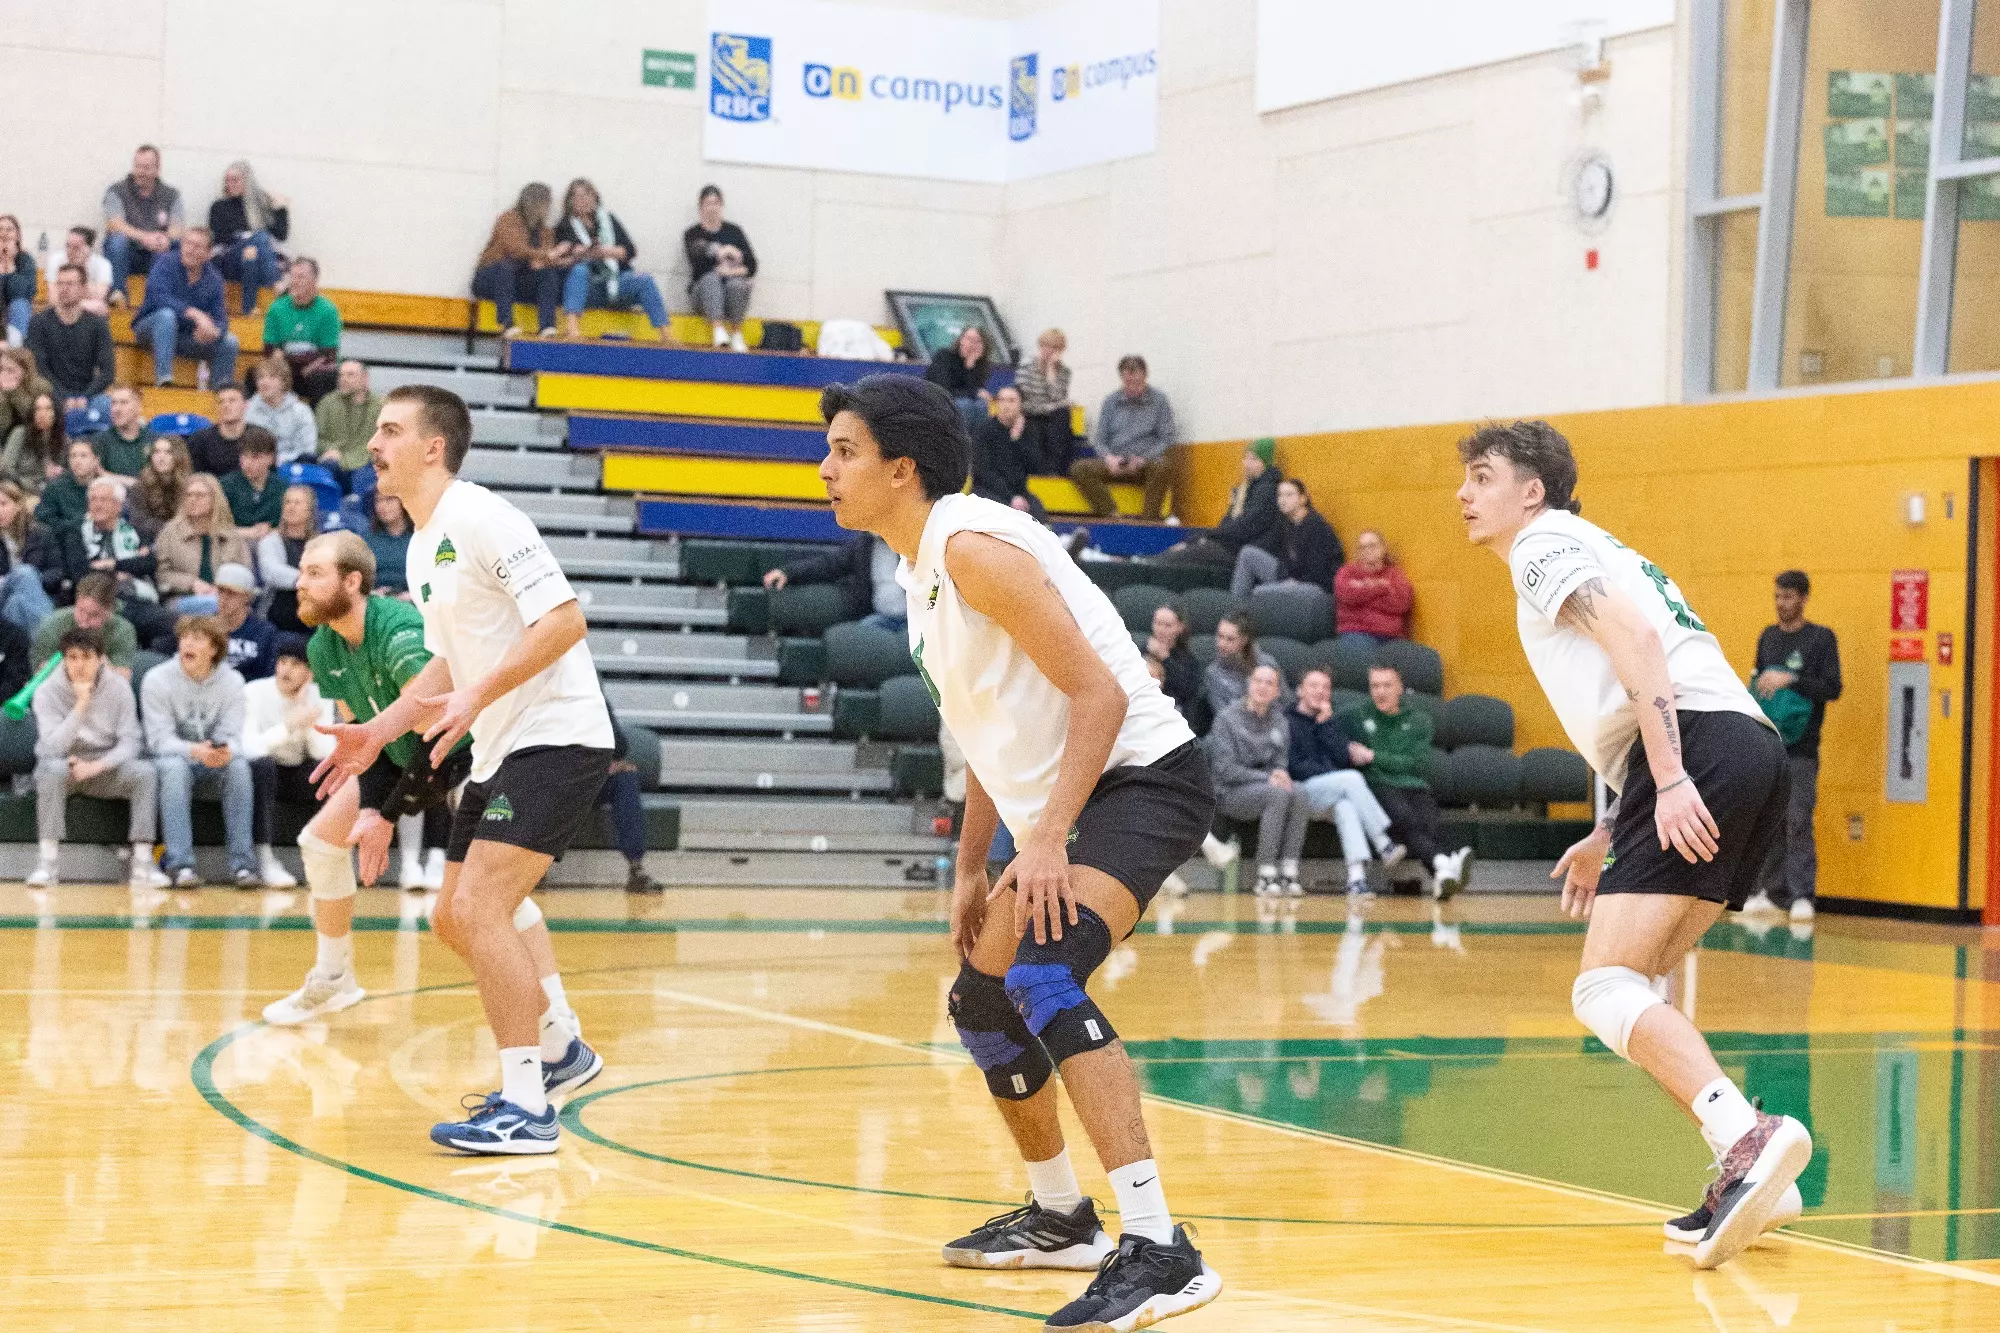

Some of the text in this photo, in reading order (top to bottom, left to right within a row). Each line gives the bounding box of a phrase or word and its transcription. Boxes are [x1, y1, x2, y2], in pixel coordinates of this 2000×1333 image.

[870, 73, 1003, 113] campus
[714, 95, 769, 119] RBC
[1527, 568, 1540, 587] CI
[1560, 567, 1582, 584] Wealth
